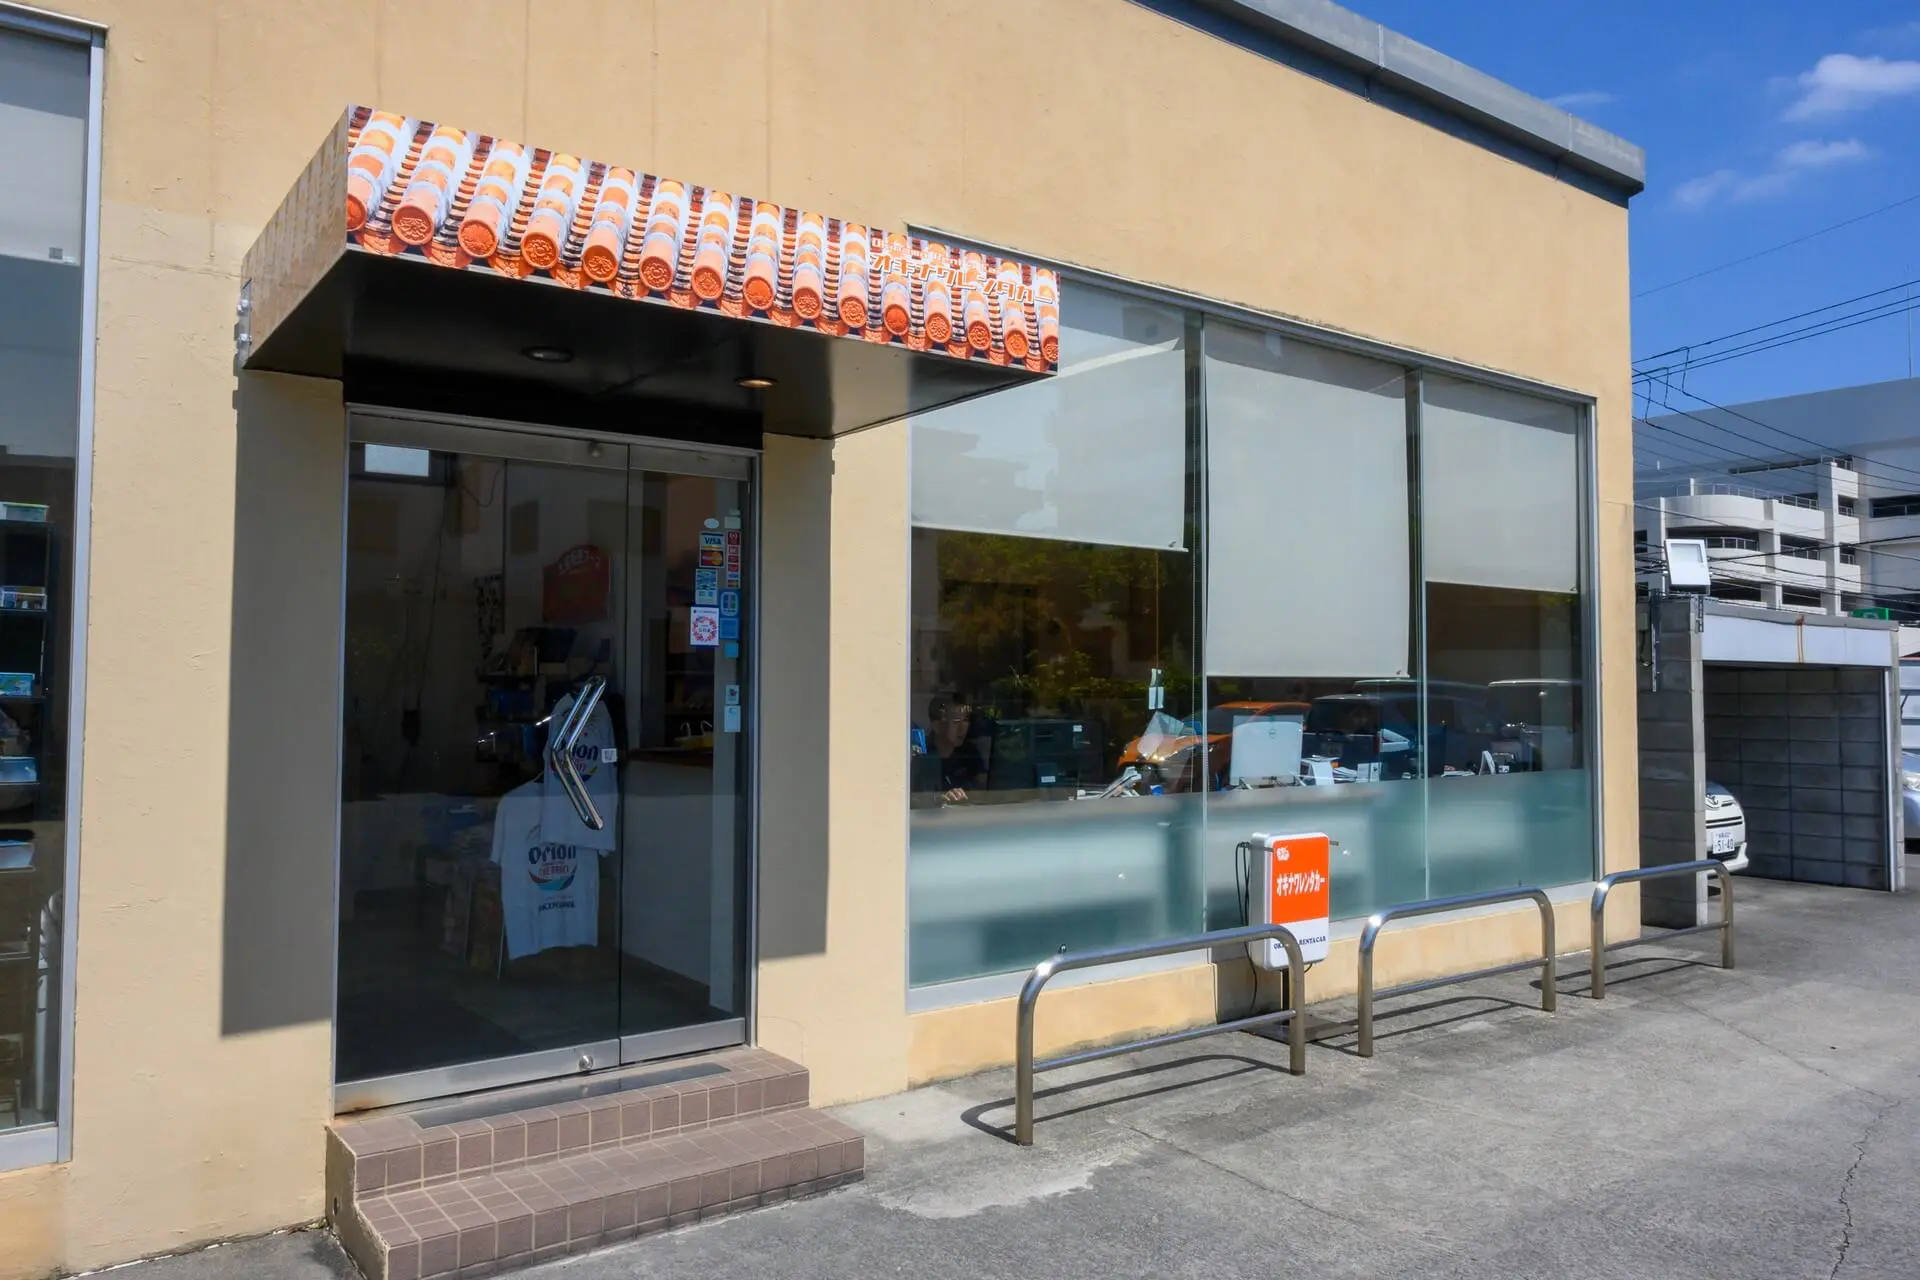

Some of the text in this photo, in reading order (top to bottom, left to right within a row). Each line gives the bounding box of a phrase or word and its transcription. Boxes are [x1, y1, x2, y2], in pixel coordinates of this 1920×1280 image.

[870, 254, 1054, 304] オキナワレンタカー
[704, 536, 721, 544] VISA
[1276, 870, 1325, 897] オキナワレンタカー
